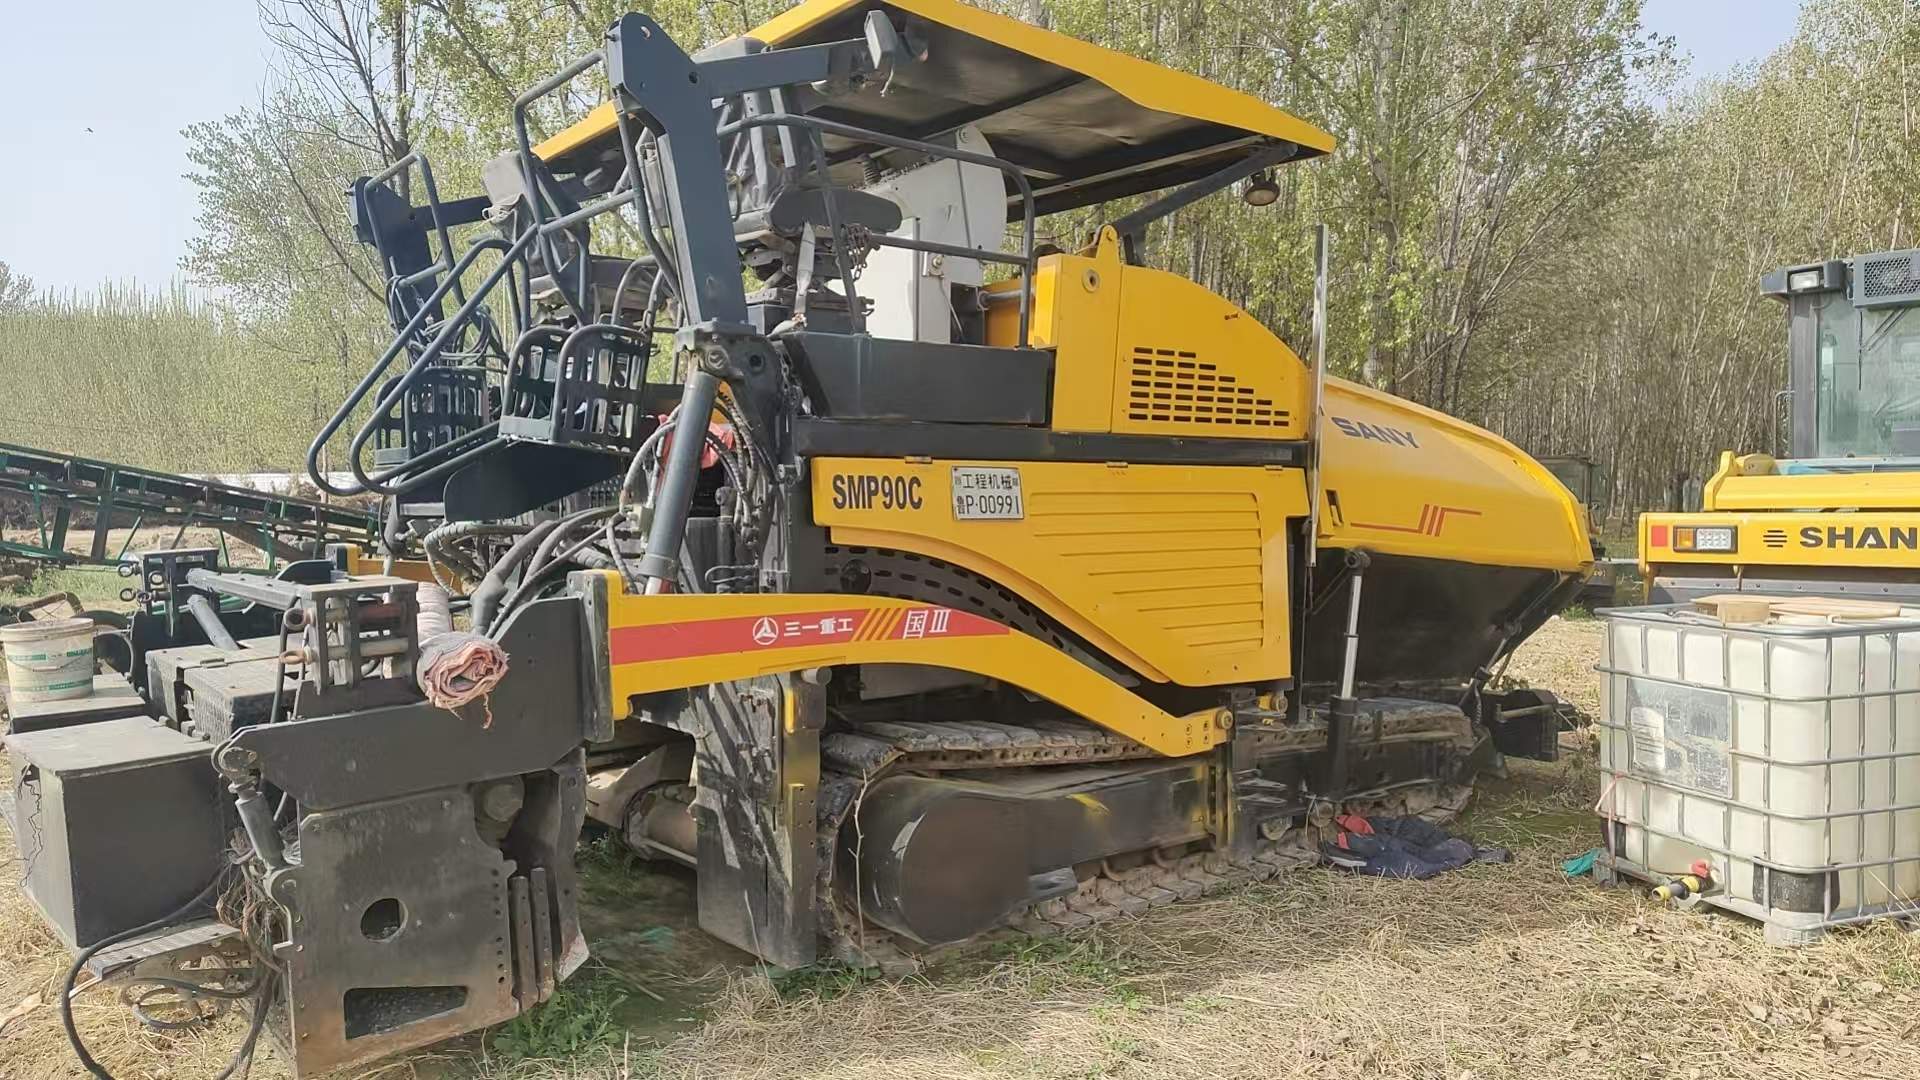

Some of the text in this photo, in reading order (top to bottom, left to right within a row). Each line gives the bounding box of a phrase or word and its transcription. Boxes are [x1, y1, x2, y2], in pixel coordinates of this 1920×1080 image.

[1331, 416, 1419, 448] SANY
[832, 474, 923, 510] SMP90C
[961, 473, 1013, 490] 工程机械
[1799, 526, 1918, 550] SHAN
[784, 616, 854, 637] 三一重工
